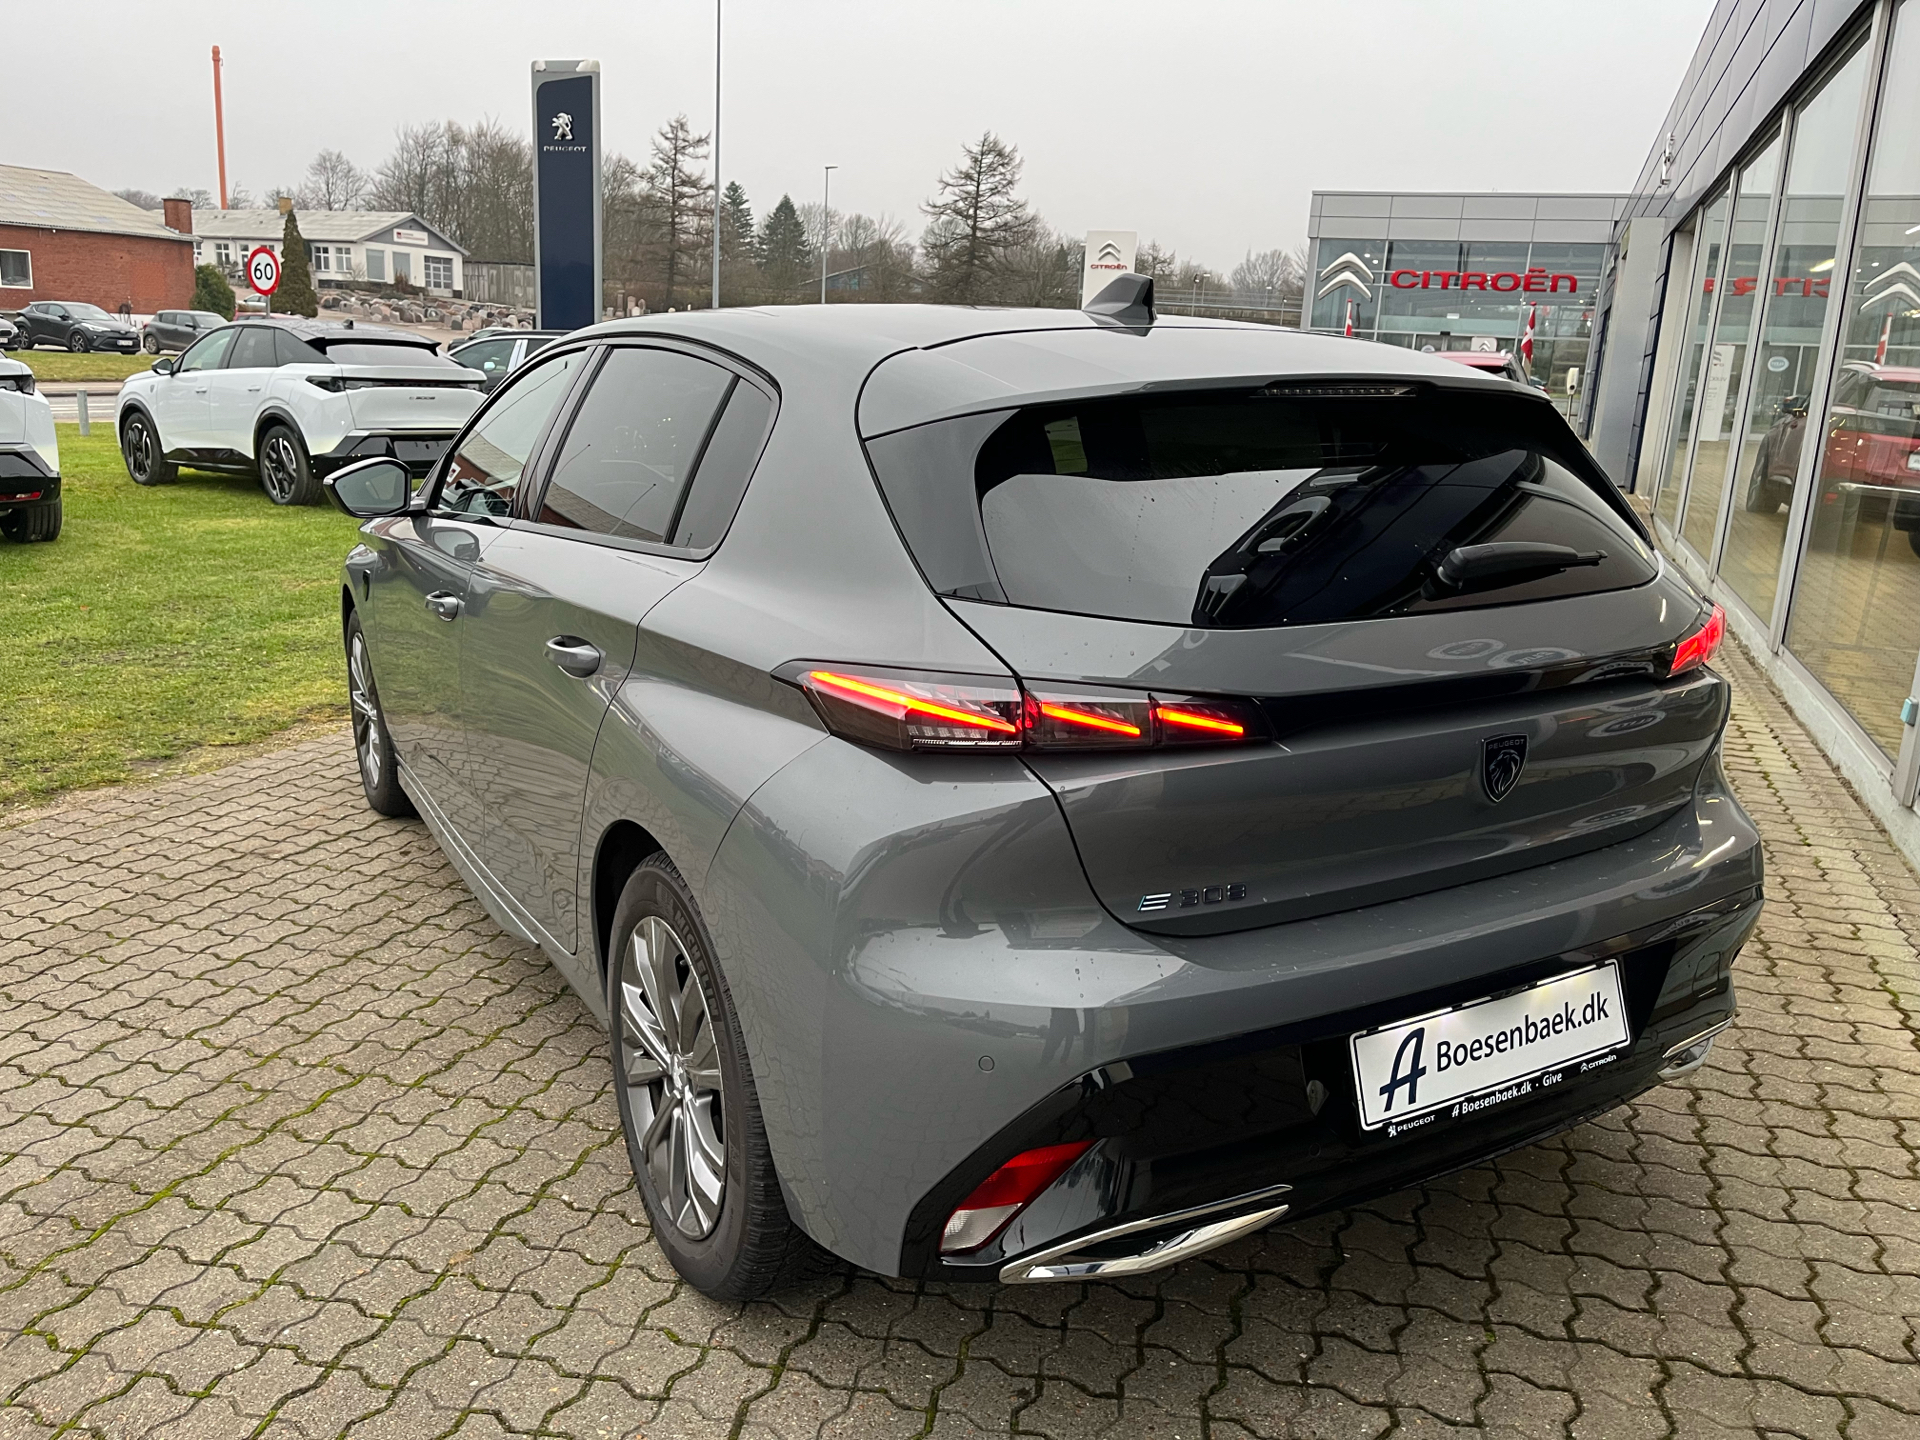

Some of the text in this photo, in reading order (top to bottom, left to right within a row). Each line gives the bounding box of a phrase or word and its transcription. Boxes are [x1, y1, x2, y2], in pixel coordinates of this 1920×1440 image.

[254, 262, 273, 280] 60
[1488, 739, 1525, 750] PEUGEOT
[1179, 883, 1246, 908] 308
[674, 910, 719, 1016] MICHELIN
[1436, 991, 1610, 1073] Boesenbaek.dk
[1461, 1081, 1532, 1114] Boesenbaek.dk
[1542, 1072, 1562, 1087] Give
[1397, 1114, 1436, 1133] PEUGEOT
